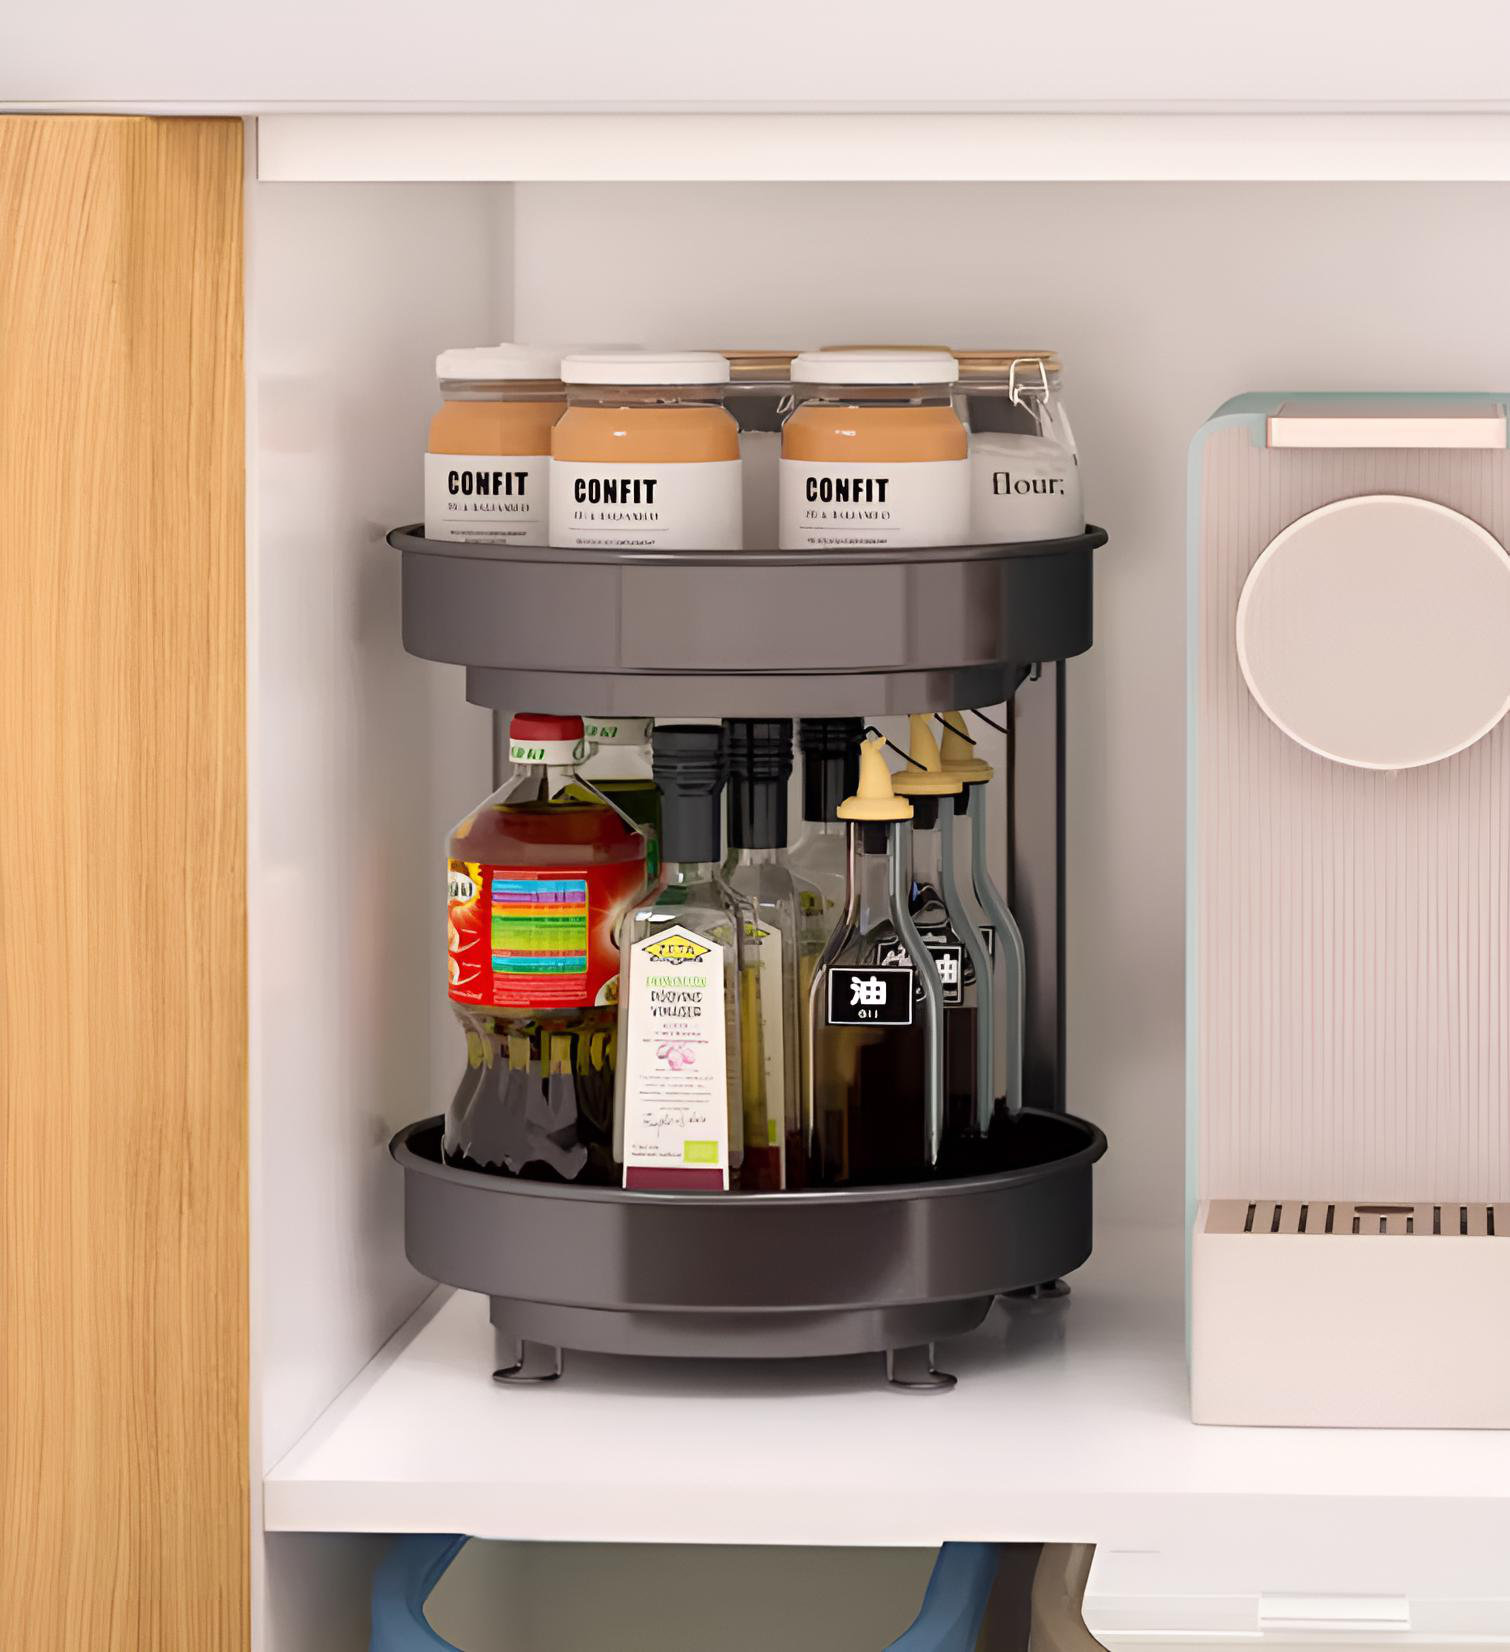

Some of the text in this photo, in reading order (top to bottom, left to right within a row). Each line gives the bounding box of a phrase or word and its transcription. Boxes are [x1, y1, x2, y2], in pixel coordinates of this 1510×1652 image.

[448, 471, 528, 495] CONFIT
[575, 479, 657, 503] CONFIT
[807, 477, 888, 502] CONFIT
[850, 976, 886, 1005] 油
